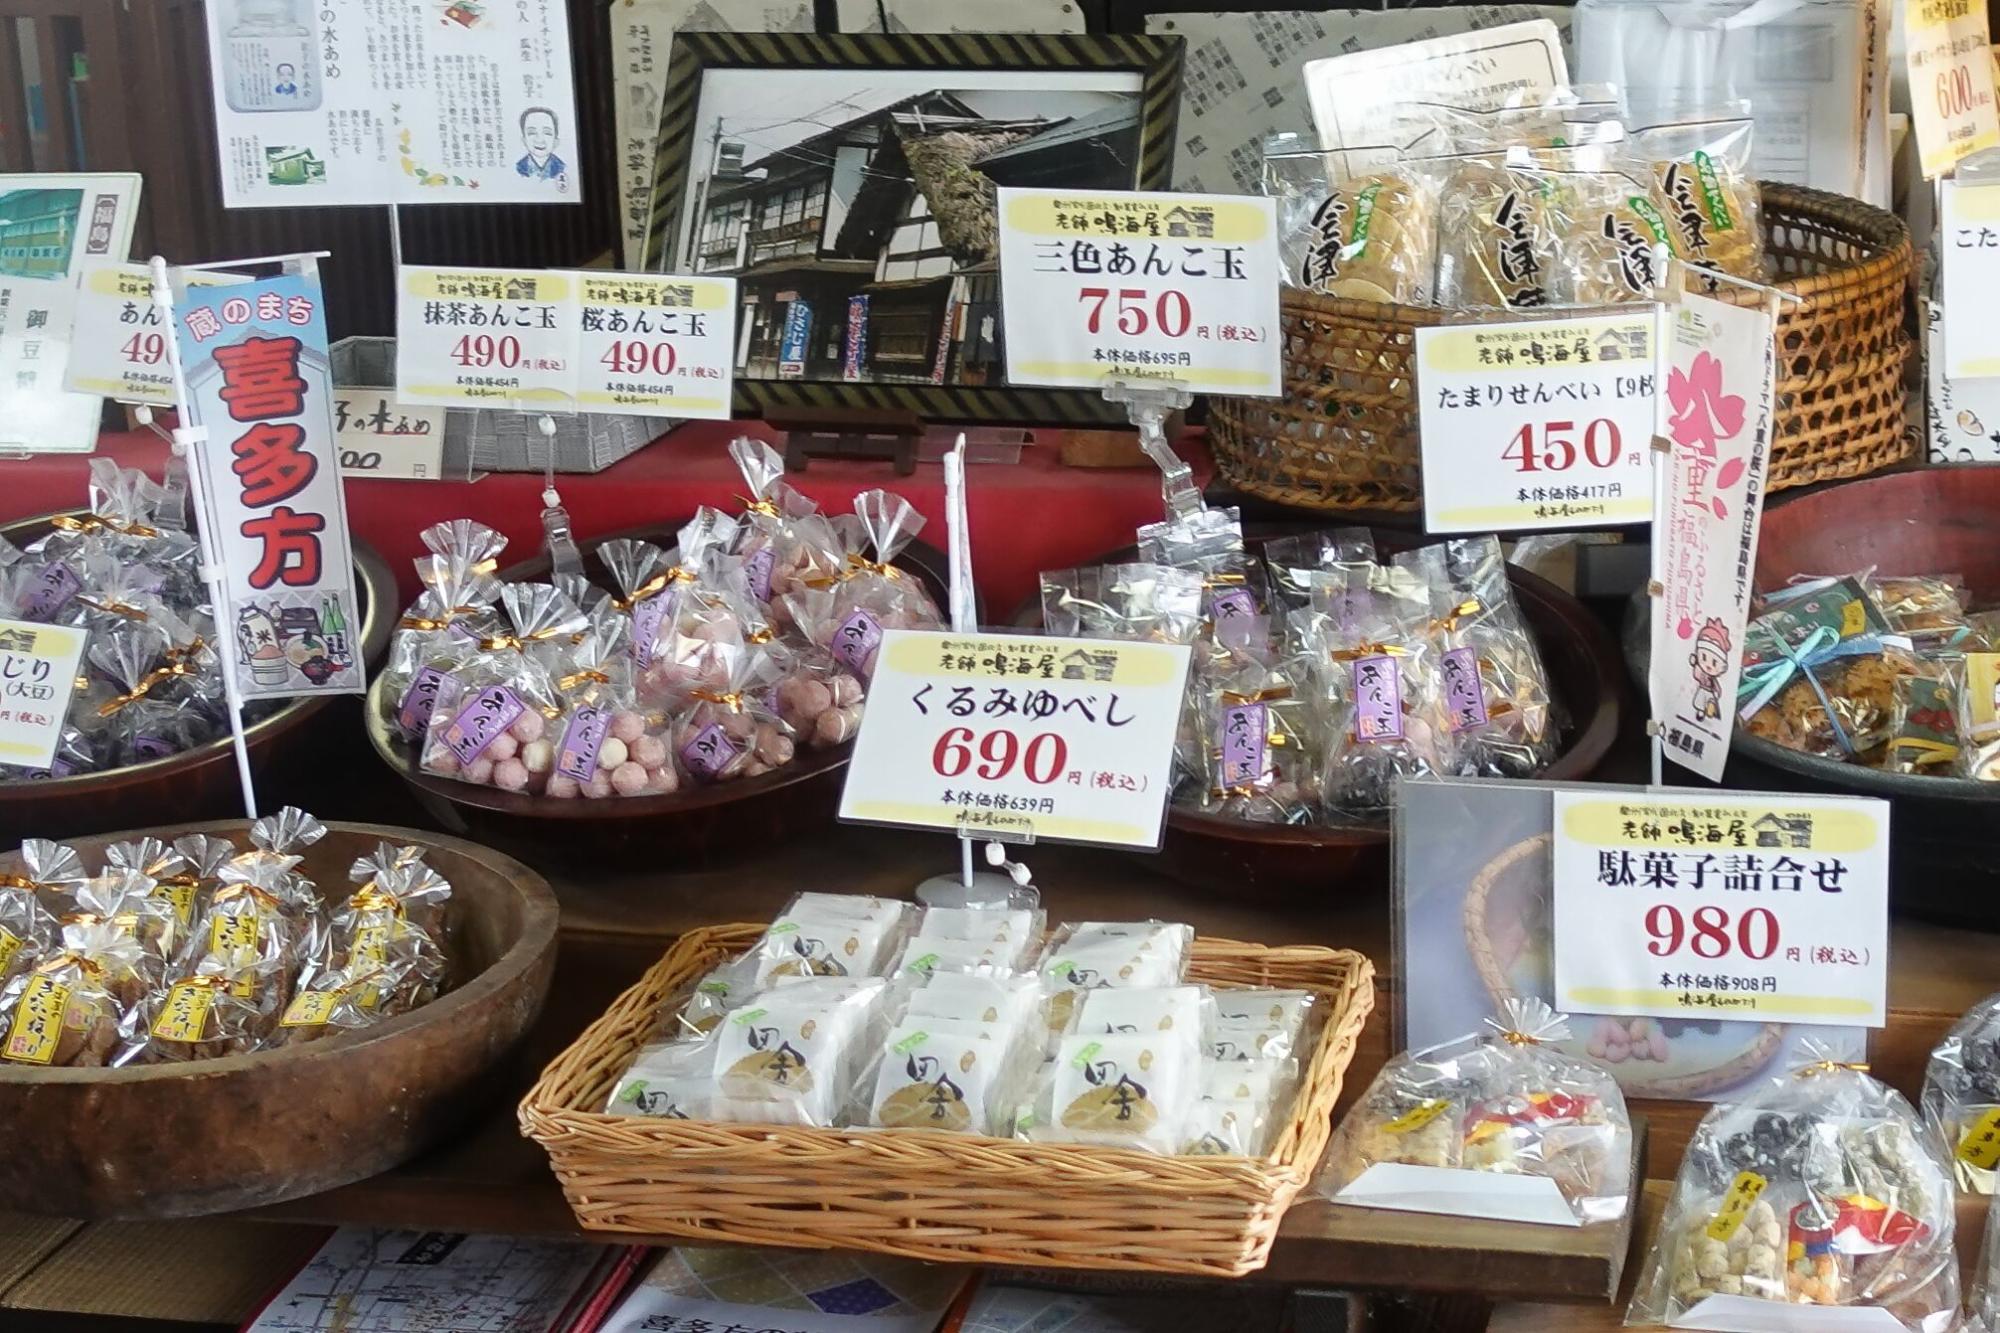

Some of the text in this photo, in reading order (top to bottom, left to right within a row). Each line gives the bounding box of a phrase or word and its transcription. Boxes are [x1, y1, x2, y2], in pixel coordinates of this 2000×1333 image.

[320, 0, 341, 79] の水あめ
[1033, 240, 1248, 280] 三色あんこ玉
[120, 301, 162, 326] あん
[185, 292, 313, 342] 蔵のまち
[424, 301, 558, 329] 抹茶あんこ玉
[581, 306, 707, 337] 桜あんこ玉
[121, 332, 171, 365] 49
[1093, 348, 1191, 366] 本体価格695円
[212, 336, 326, 594] 喜多方
[339, 448, 382, 470] 00
[1516, 483, 1621, 502] 本体価格417円
[912, 683, 1136, 727] くるみゆべし
[941, 789, 1054, 813] 本体価格639円
[1597, 849, 1849, 893] 駄菓子詰合せ
[1660, 973, 1777, 992] 本体価格908円
